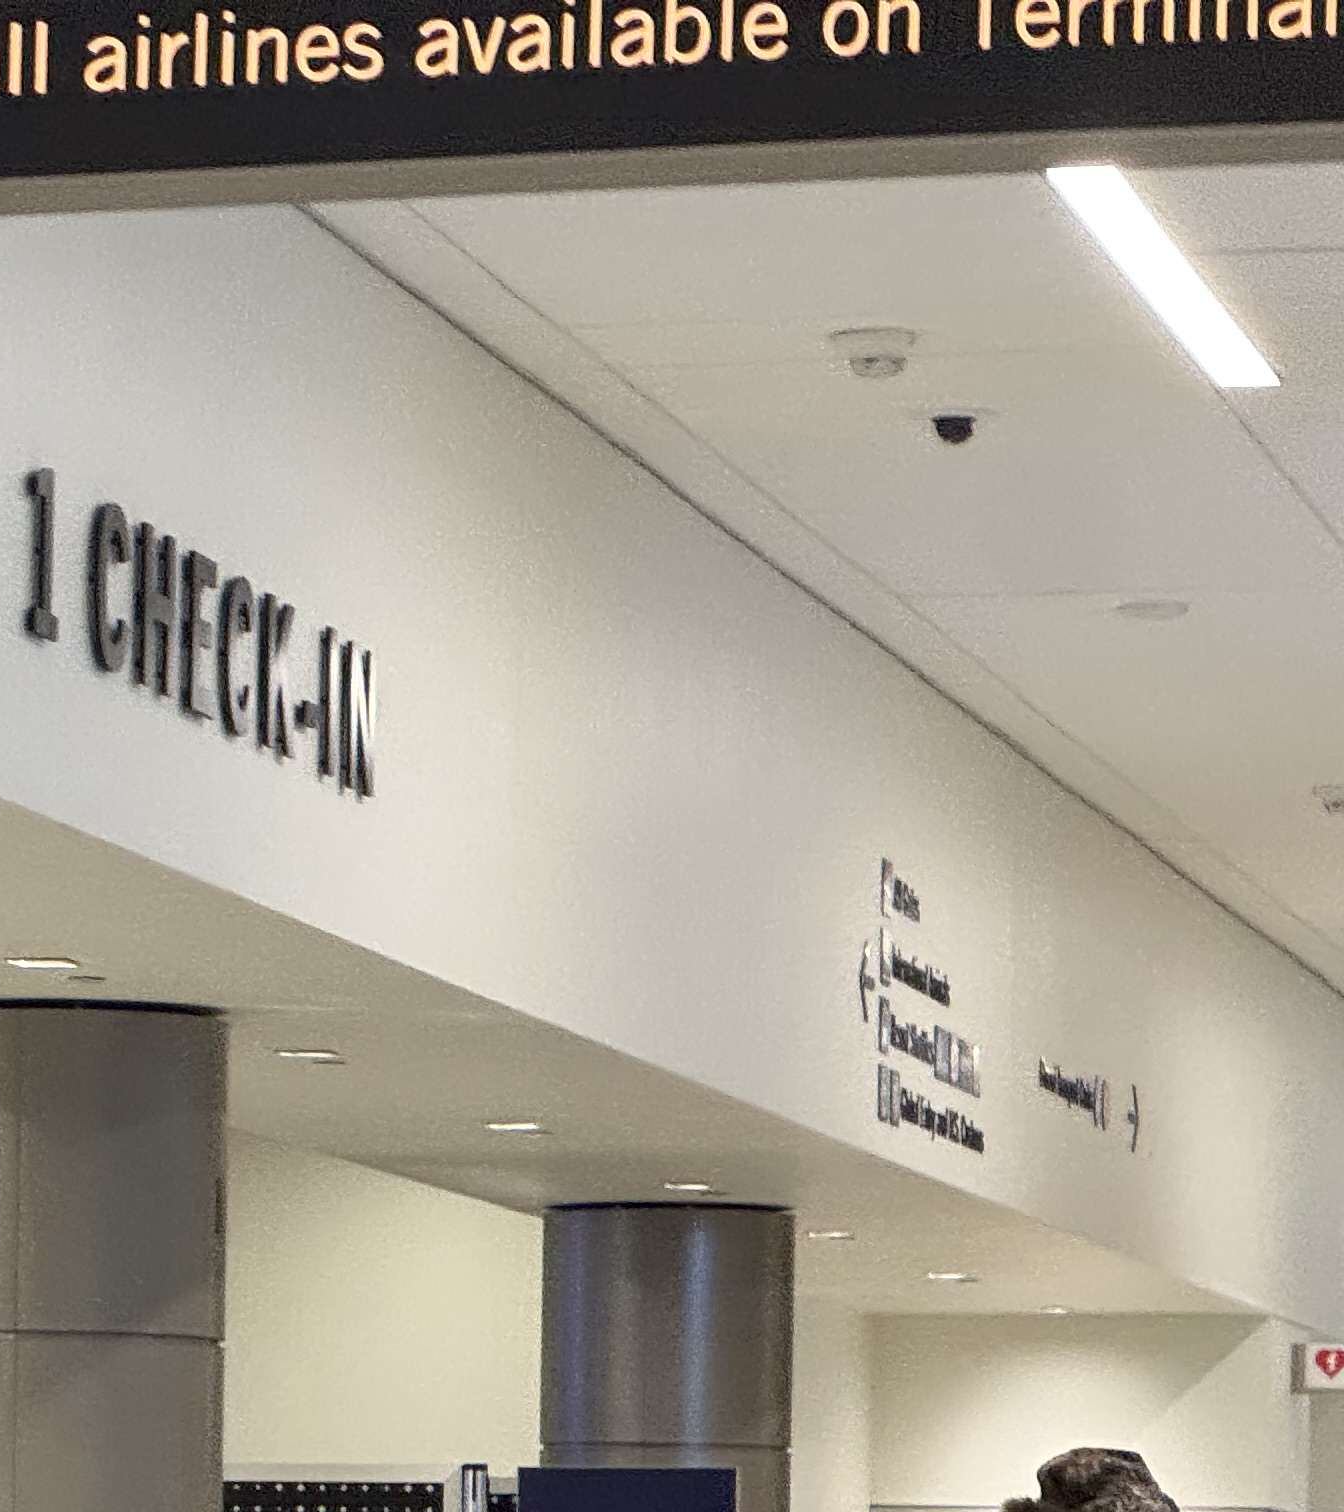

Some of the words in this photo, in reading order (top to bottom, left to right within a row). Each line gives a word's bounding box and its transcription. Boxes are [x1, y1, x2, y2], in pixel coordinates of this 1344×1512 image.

[83, 10, 385, 94] airlines
[413, 0, 791, 79] available
[822, 0, 920, 57] on
[24, 466, 59, 642] 1
[88, 501, 377, 801] CHECK-IN
